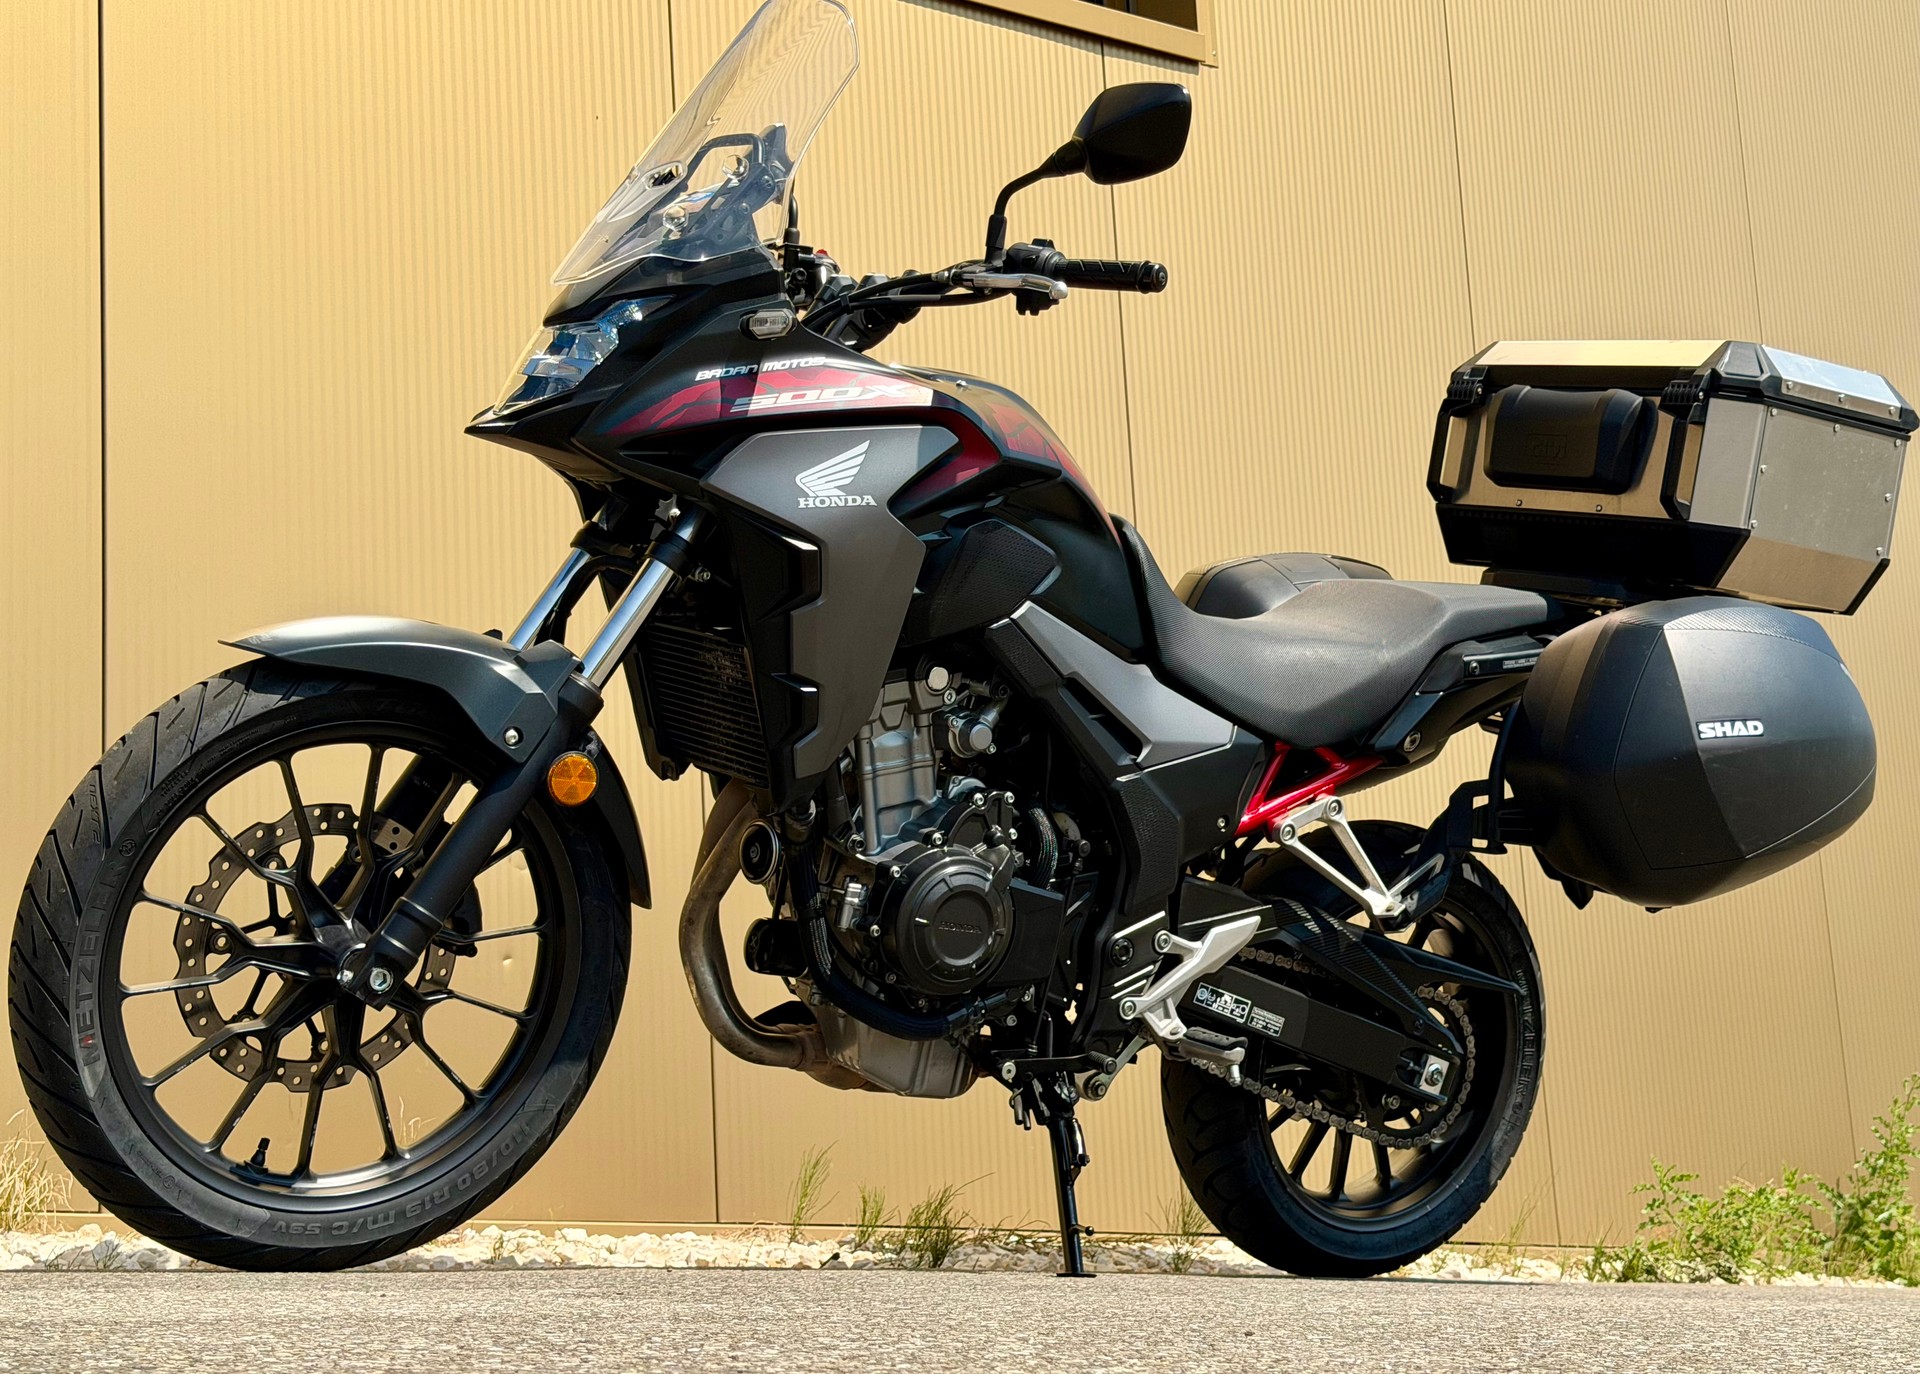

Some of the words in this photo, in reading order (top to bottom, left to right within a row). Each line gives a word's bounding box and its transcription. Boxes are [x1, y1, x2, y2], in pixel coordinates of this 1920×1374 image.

[694, 364, 758, 381] BADAN
[762, 357, 826, 372] MOTOS
[730, 384, 909, 412] 500X
[797, 495, 878, 509] HONDA
[1698, 720, 1765, 739] SHAD
[405, 1186, 451, 1218] R19
[272, 1220, 322, 1236] 59V
